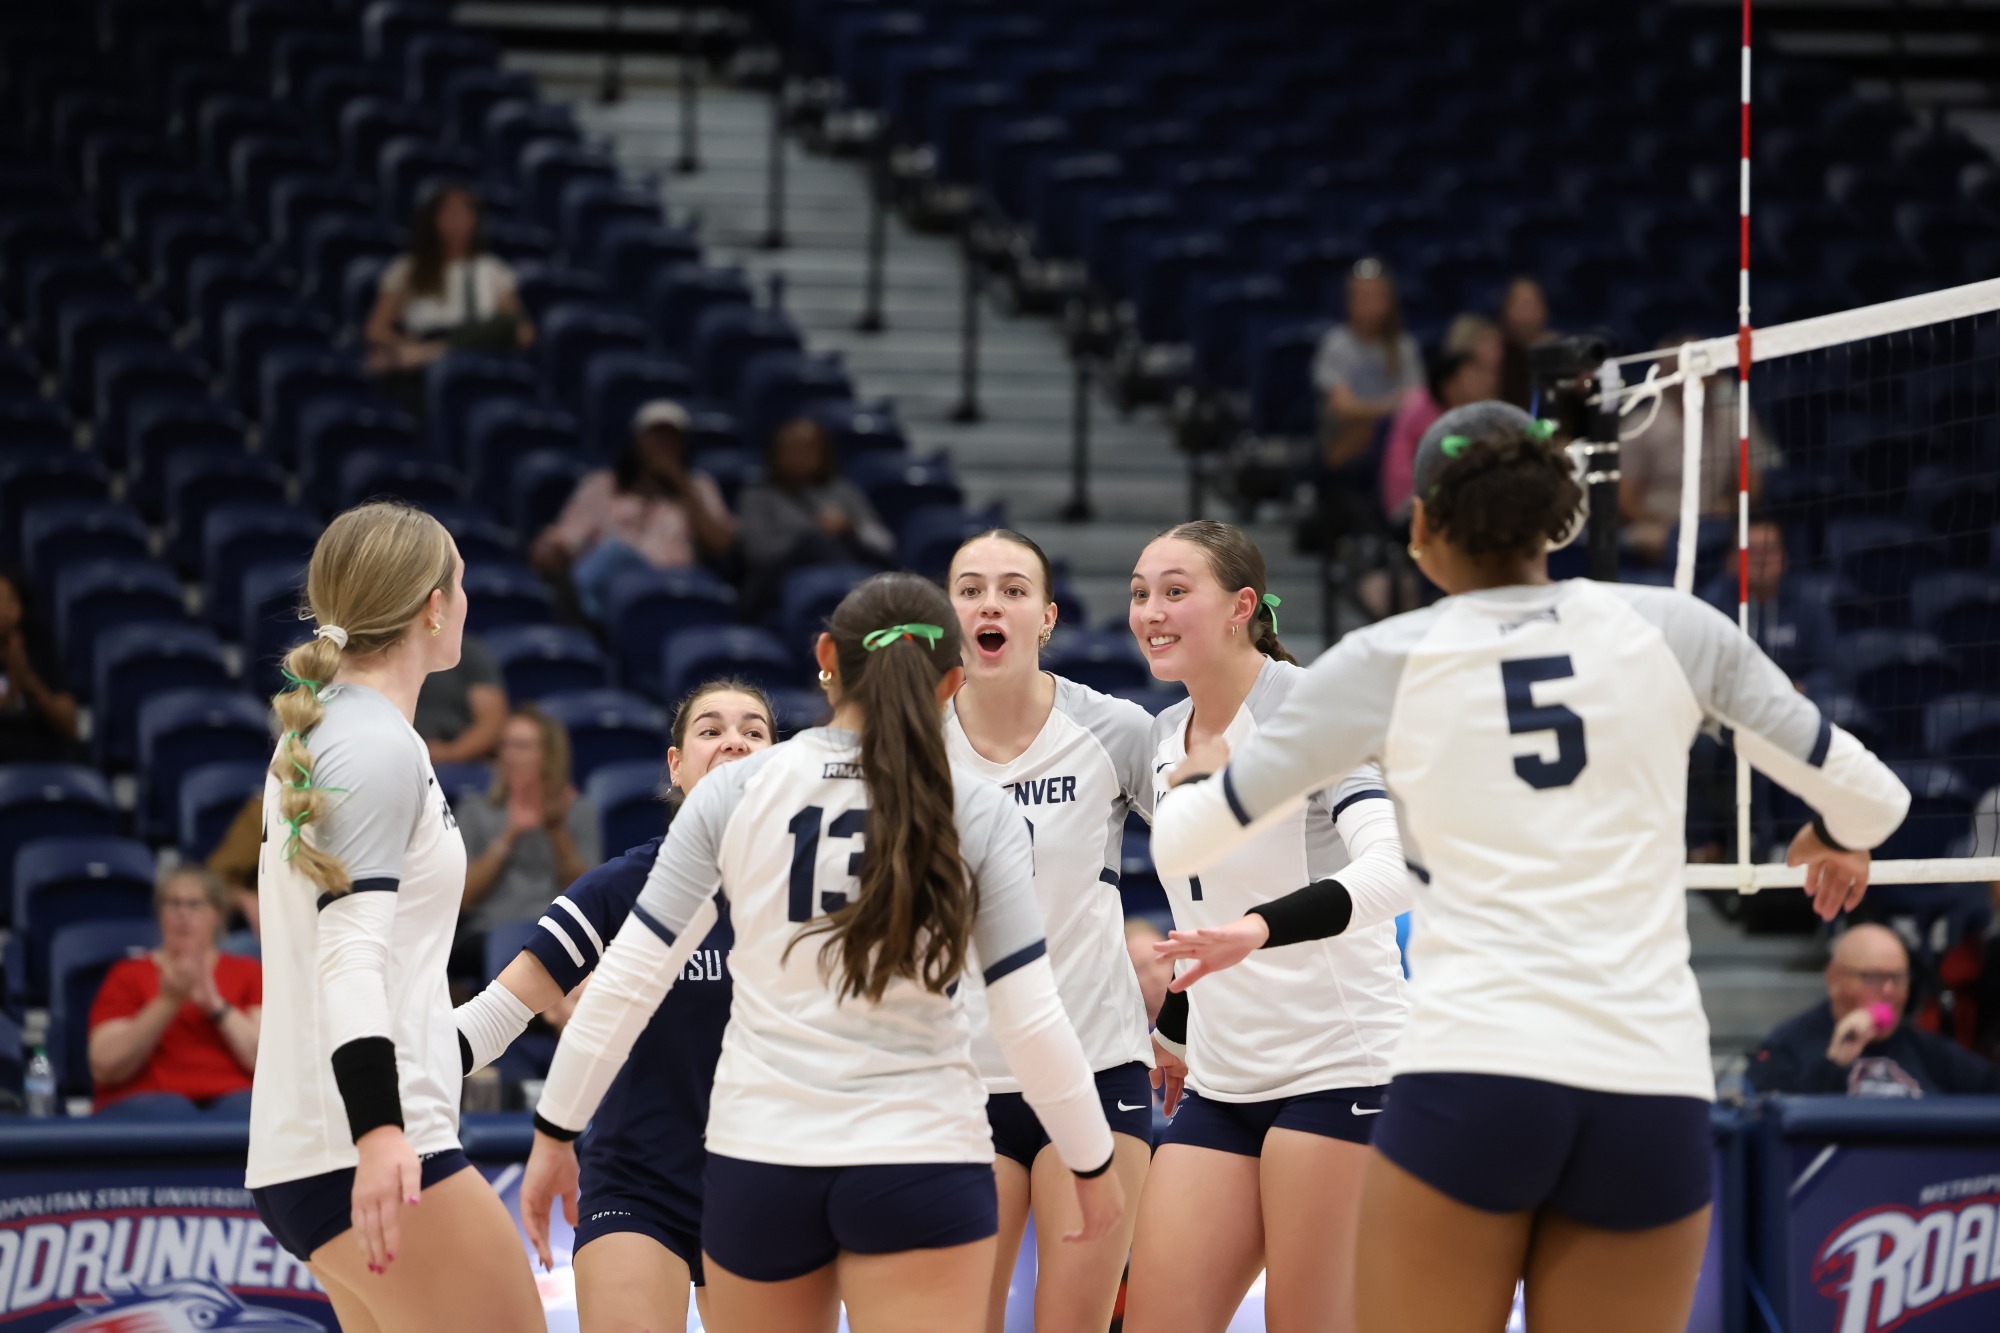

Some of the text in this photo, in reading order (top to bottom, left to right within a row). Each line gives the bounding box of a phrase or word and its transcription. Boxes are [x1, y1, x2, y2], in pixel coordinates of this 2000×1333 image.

[1500, 654, 1587, 790] 5
[1002, 775, 1076, 806] NVER
[788, 805, 870, 922] 13
[95, 1186, 150, 1210] STATE
[0, 1216, 326, 1316] DRUNNER
[1821, 1203, 2000, 1333] ROA
